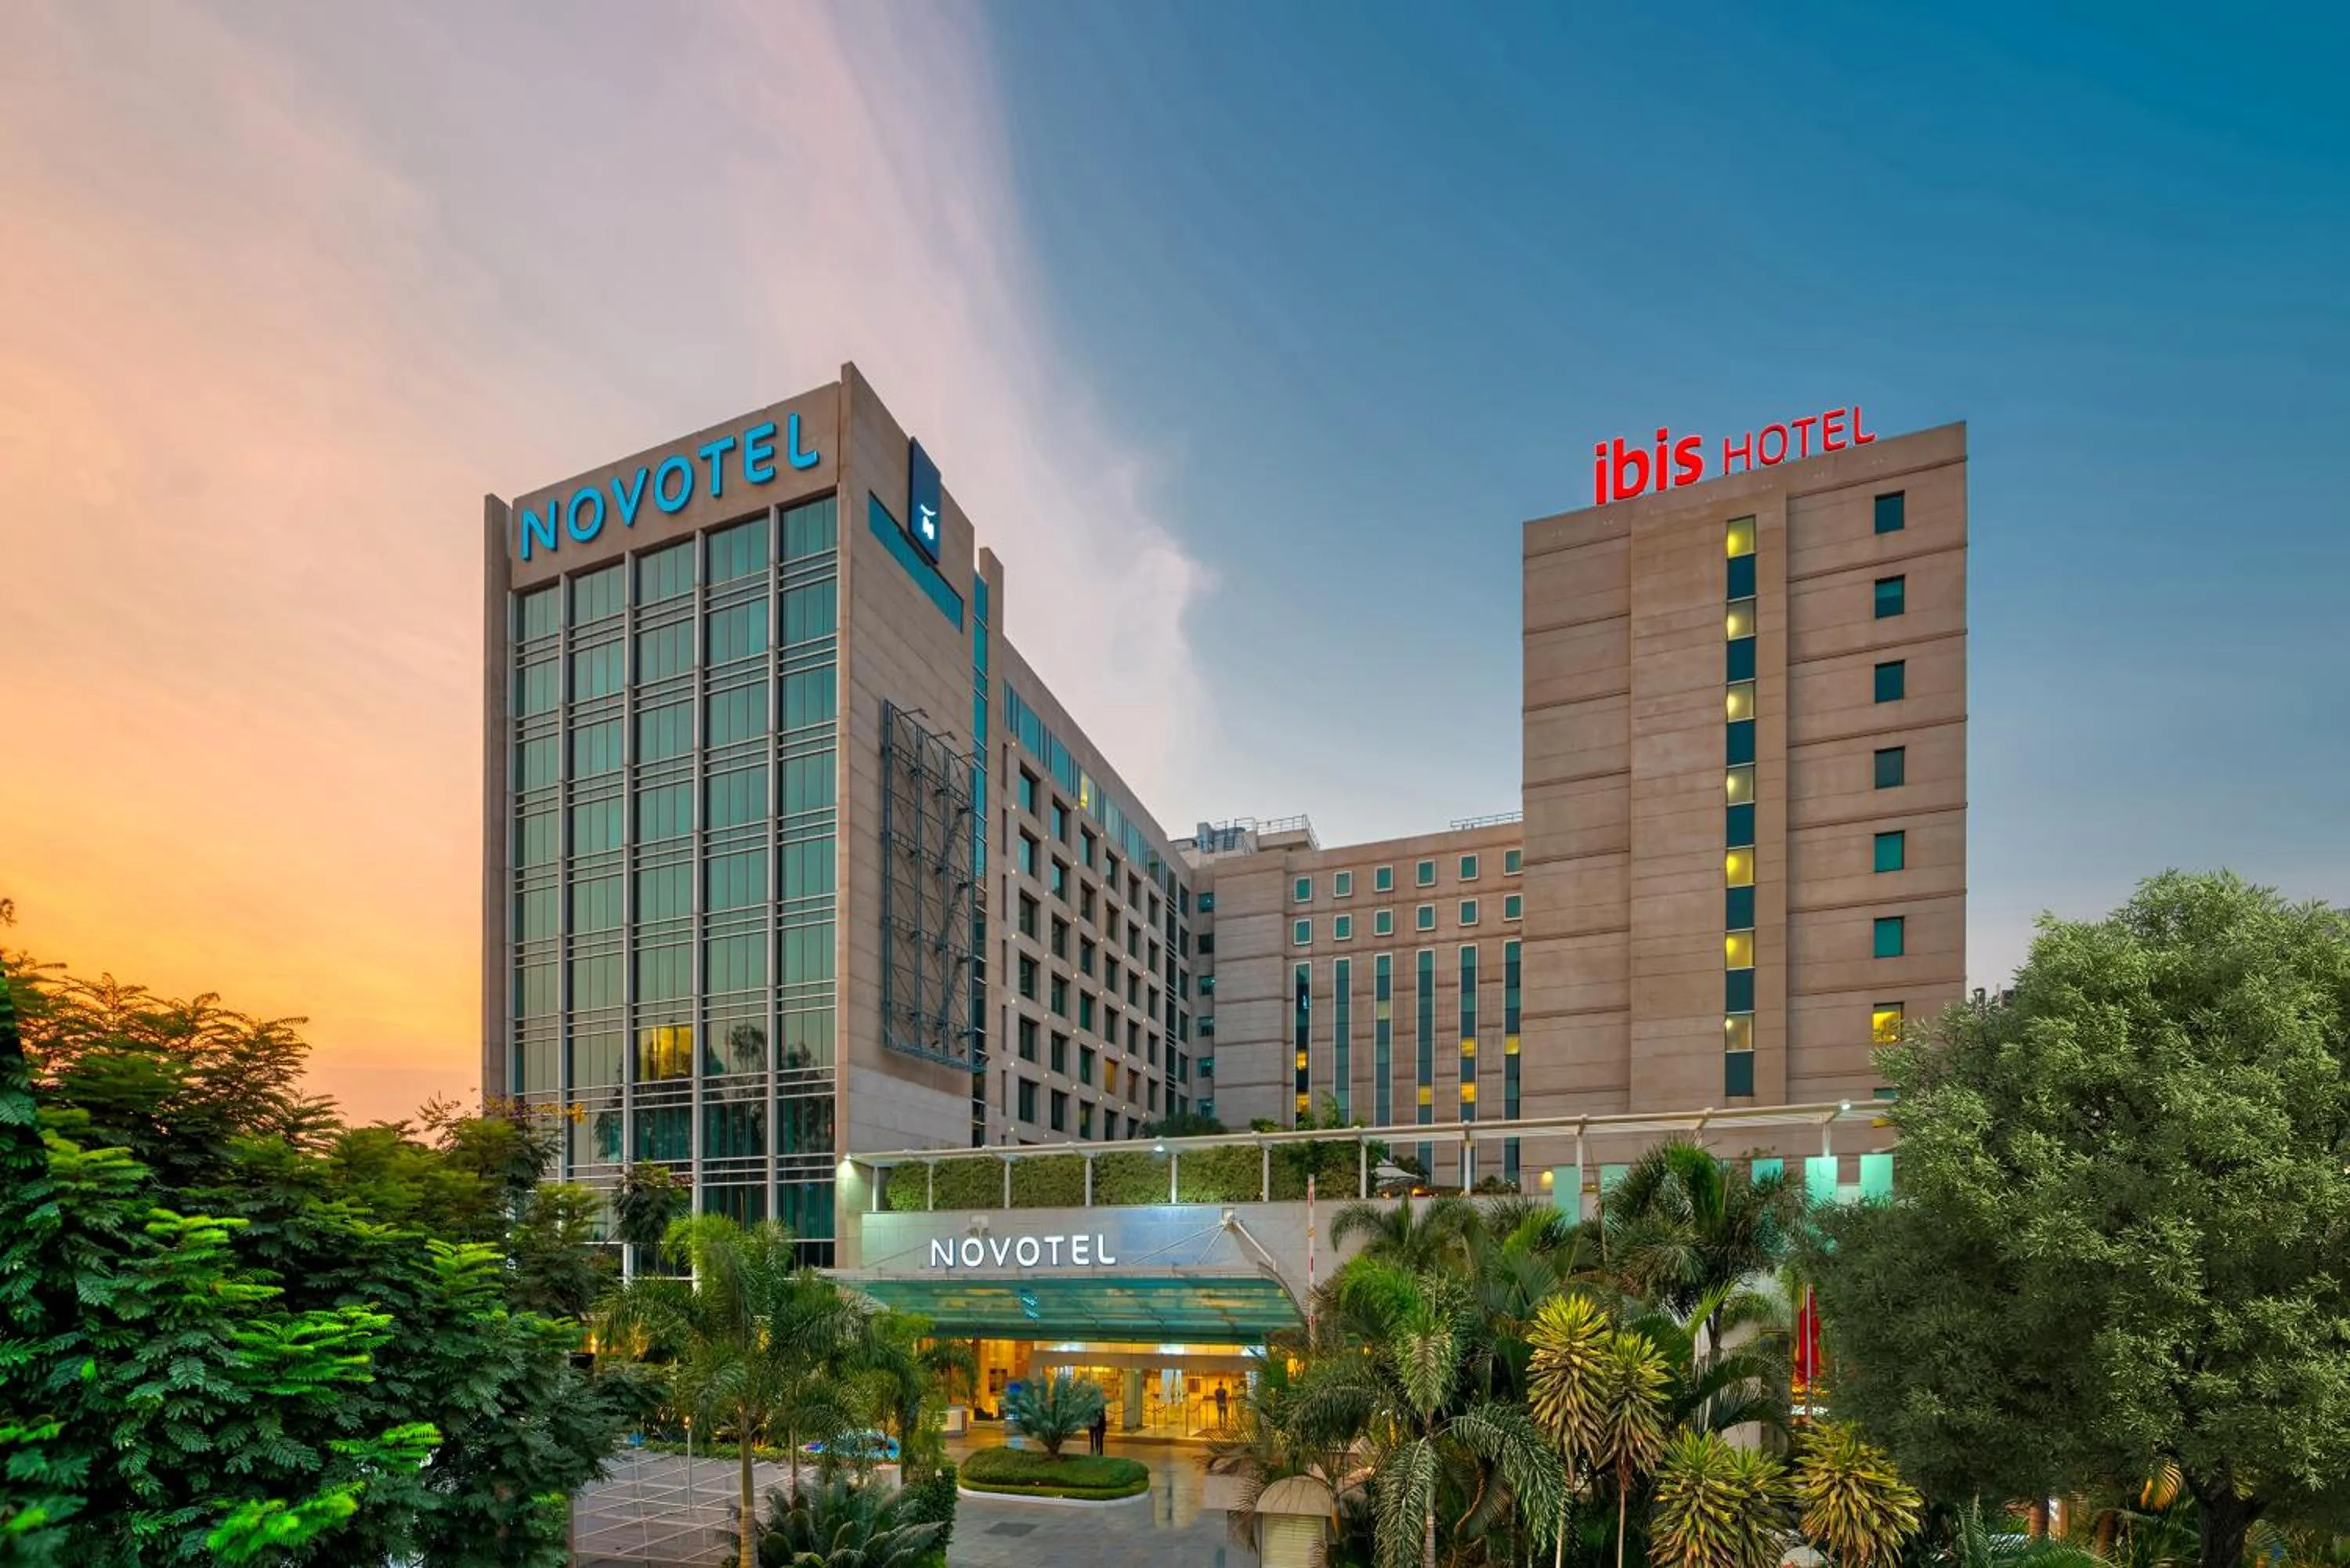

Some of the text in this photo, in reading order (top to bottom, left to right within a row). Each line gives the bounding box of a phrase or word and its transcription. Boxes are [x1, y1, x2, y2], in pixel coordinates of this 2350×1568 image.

[520, 412, 819, 562] NOVOTEL
[1595, 406, 1876, 505] ibis HOTEL
[930, 1234, 1117, 1267] NOVOTEL
